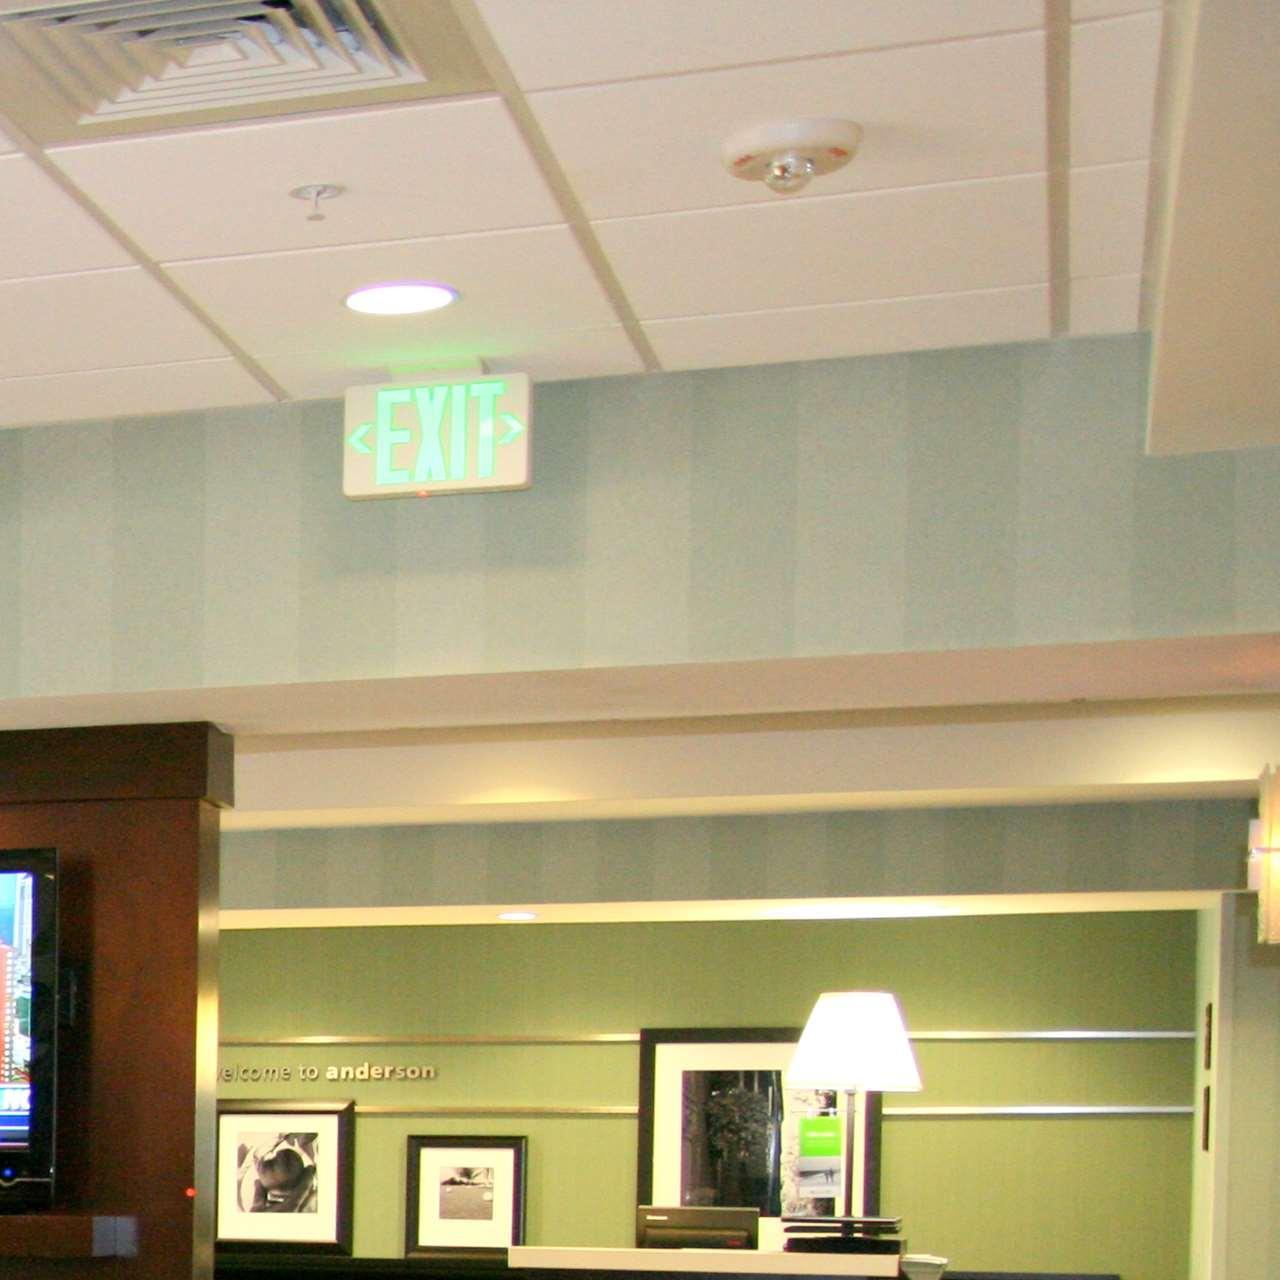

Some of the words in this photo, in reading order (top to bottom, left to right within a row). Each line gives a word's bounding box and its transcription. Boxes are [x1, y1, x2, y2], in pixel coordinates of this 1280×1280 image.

[375, 380, 506, 486] EXIT
[299, 1064, 319, 1081] to
[326, 1062, 436, 1082] anderson
